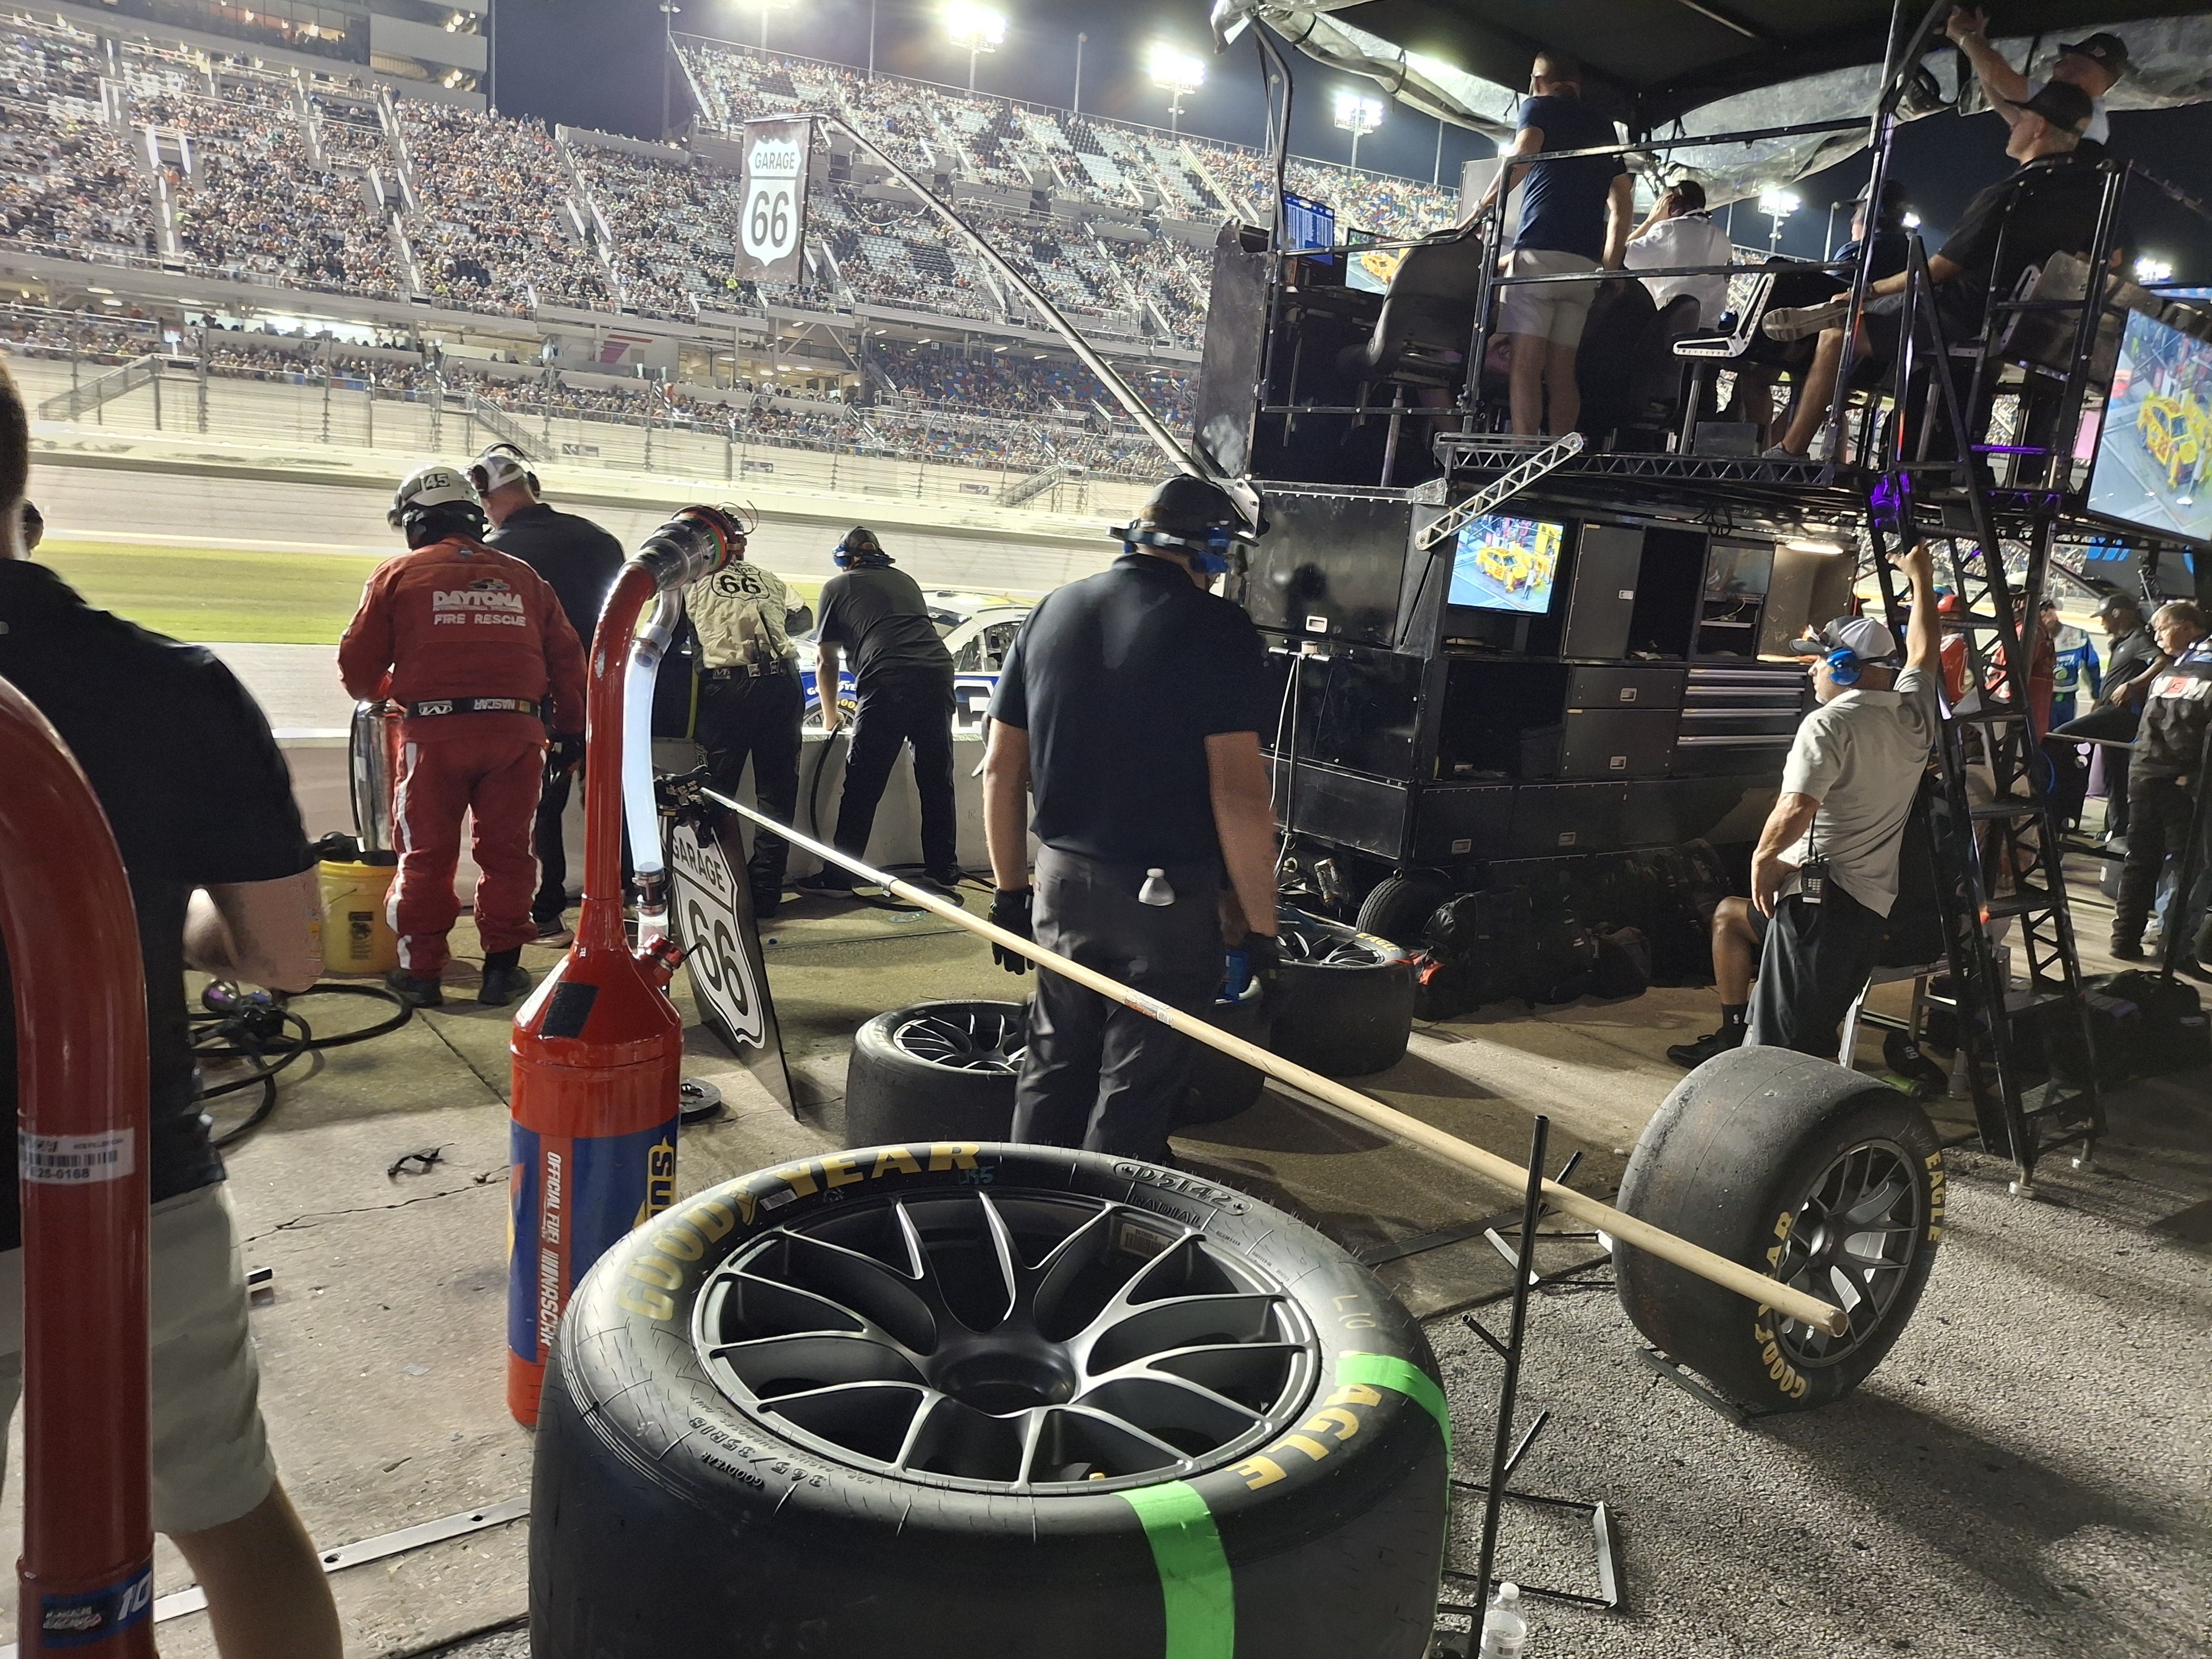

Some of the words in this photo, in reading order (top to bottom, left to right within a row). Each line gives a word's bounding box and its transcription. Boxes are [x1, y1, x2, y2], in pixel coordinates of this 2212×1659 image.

[755, 152, 795, 169] GARAGE
[751, 190, 789, 248] 66
[425, 473, 449, 488] 45
[433, 590, 524, 610] DAYTONA
[720, 575, 761, 594] 66
[434, 613, 466, 625] FIRE
[474, 613, 526, 627] RESCUE
[672, 836, 726, 893] GARAGE
[688, 898, 749, 1017] 66
[1355, 932, 1401, 953] EAGLE
[546, 1151, 562, 1210] OFFICIAL
[1132, 1167, 1233, 1209] D5142
[1925, 1150, 1945, 1242] EAGLE
[546, 1213, 561, 1245] FUEL
[1130, 1194, 1201, 1228] RADIAL
[616, 1142, 981, 1321] GOODYEAR
[1224, 1351, 1382, 1491] AGLE
[701, 1451, 766, 1489] GOODYEAR
